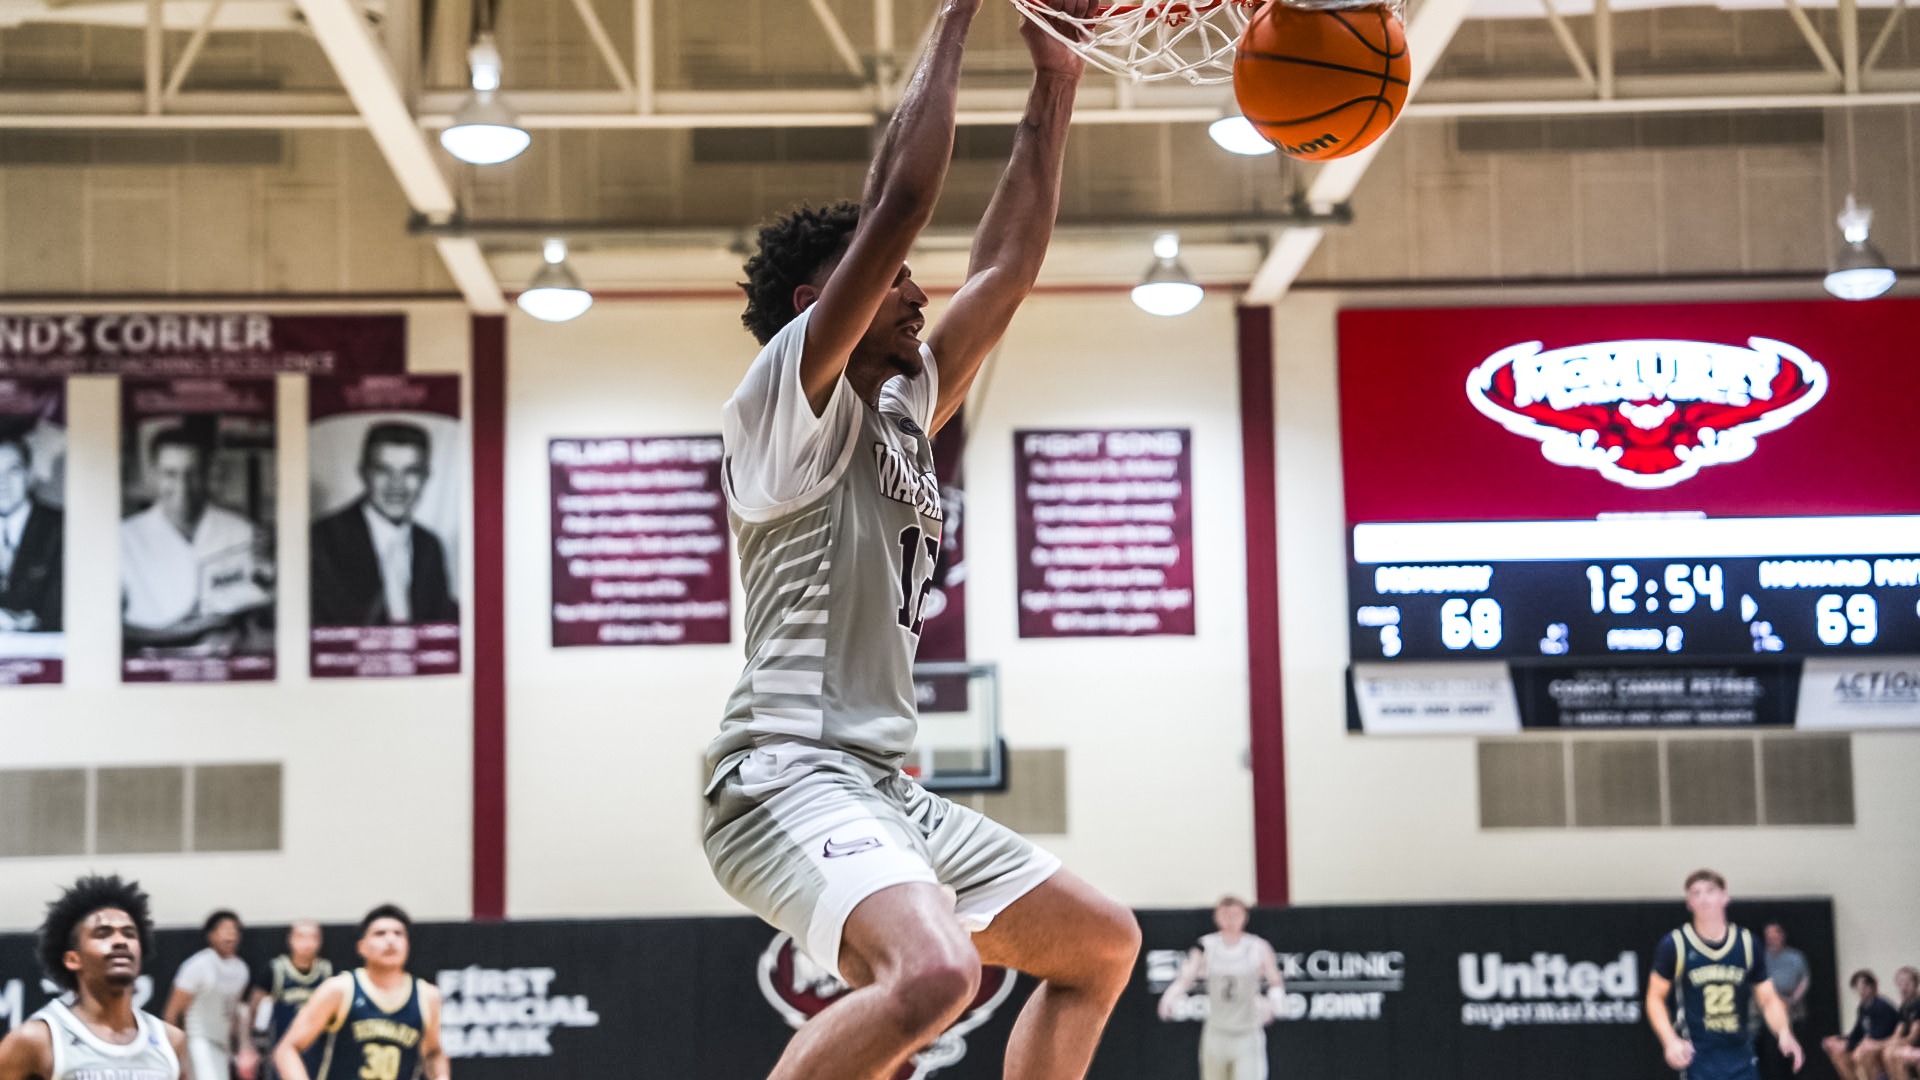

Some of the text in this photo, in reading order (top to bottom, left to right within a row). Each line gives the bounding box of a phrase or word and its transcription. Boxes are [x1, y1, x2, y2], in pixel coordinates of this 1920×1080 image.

[95, 313, 272, 351] CORNER
[1106, 431, 1182, 457] SONG
[1586, 564, 1724, 614] 12:54
[1441, 598, 1502, 650] 68
[1816, 594, 1878, 645] 69
[437, 965, 555, 998] FIRST
[1306, 950, 1405, 979] CLINIC
[1458, 950, 1639, 1000] United
[1308, 992, 1384, 1020] JOINT
[1461, 1002, 1641, 1030] supermarkets
[1703, 984, 1736, 1015] 22
[359, 1043, 401, 1080] 30
